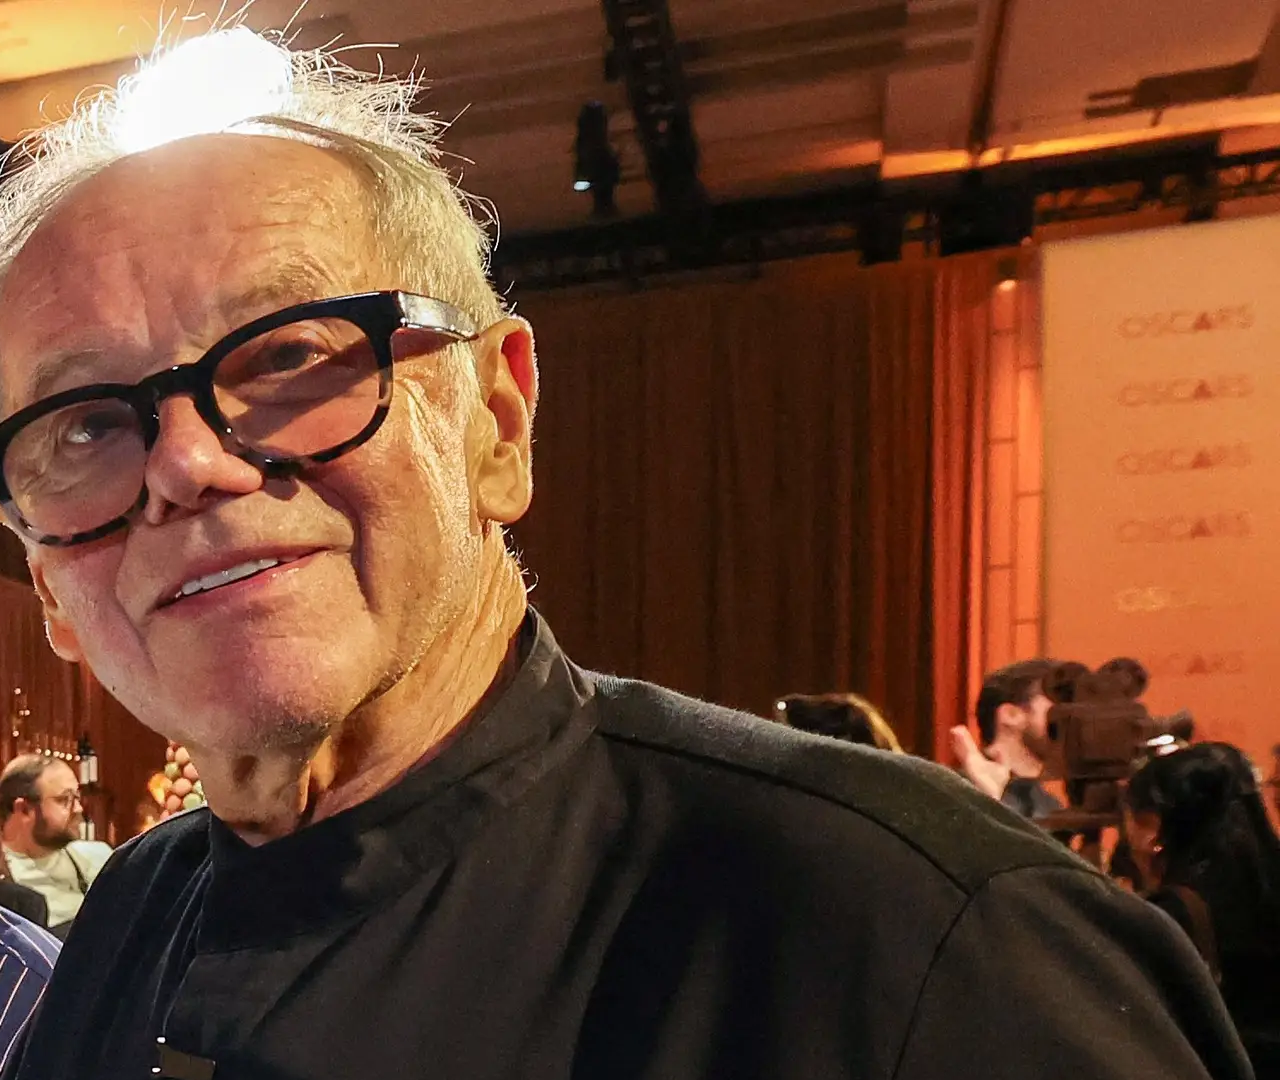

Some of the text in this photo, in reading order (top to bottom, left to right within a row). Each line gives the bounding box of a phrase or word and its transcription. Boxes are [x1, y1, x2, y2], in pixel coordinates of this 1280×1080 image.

[1117, 304, 1254, 339] OSCARS
[1116, 374, 1253, 406] OSCARS
[1115, 443, 1251, 475] OSCARS
[1115, 511, 1251, 544] OSCARS
